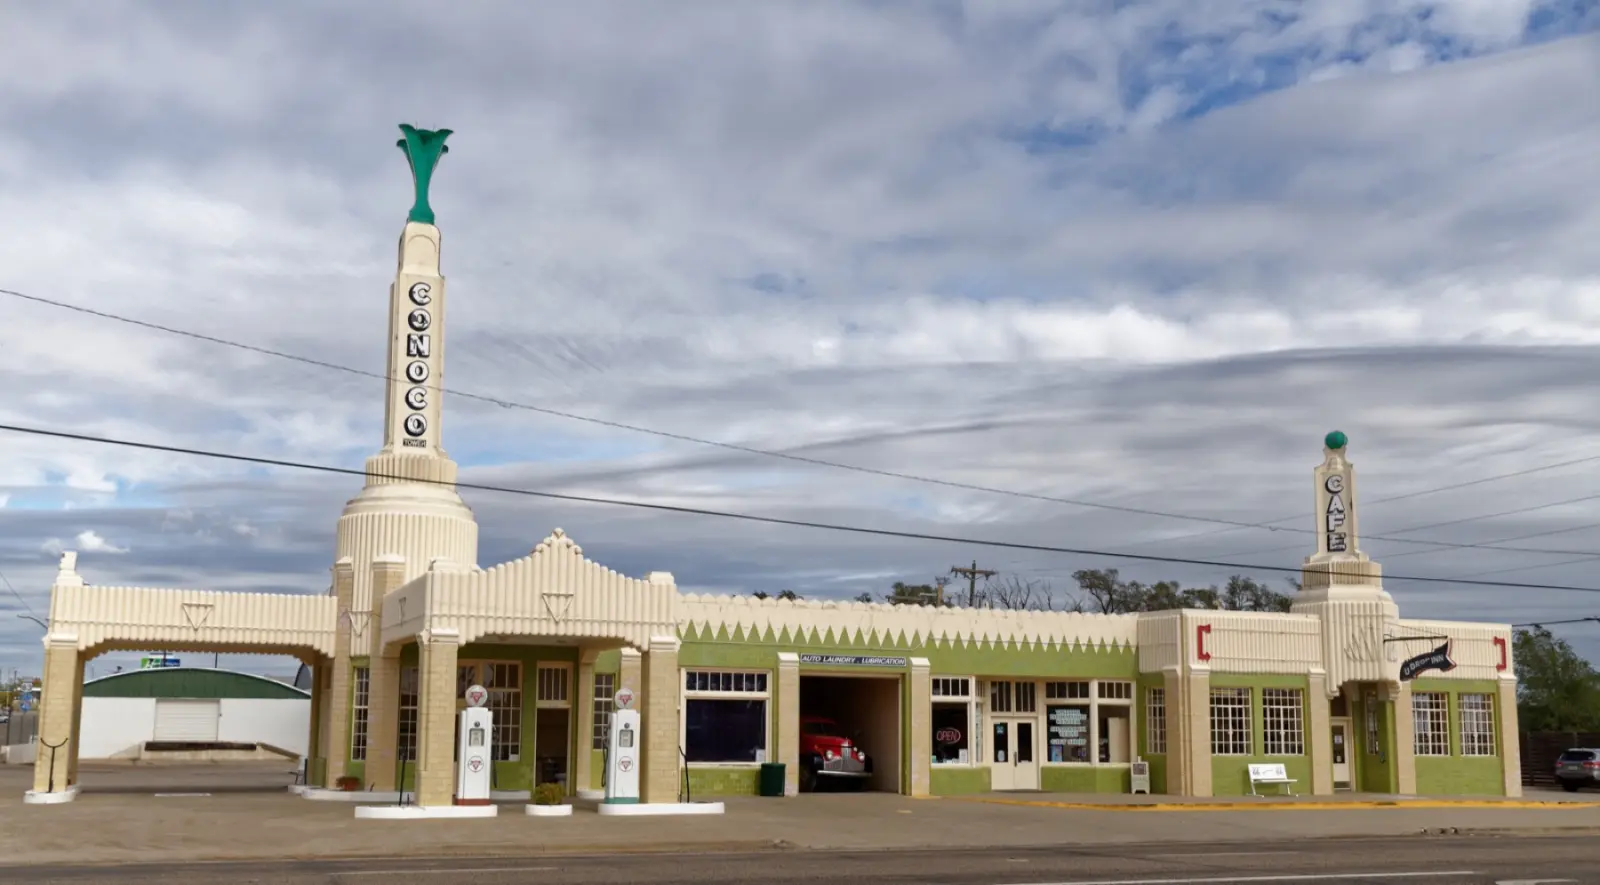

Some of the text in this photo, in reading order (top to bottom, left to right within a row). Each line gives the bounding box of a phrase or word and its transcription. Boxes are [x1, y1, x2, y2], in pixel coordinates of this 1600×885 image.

[404, 282, 431, 437] CONOCO
[403, 438, 426, 448] TOWER
[1325, 474, 1347, 552] CAFE
[861, 657, 905, 665] LUBRICATION
[1404, 667, 1410, 675] U
[1431, 655, 1445, 664] INN
[936, 730, 957, 741] OPEN
